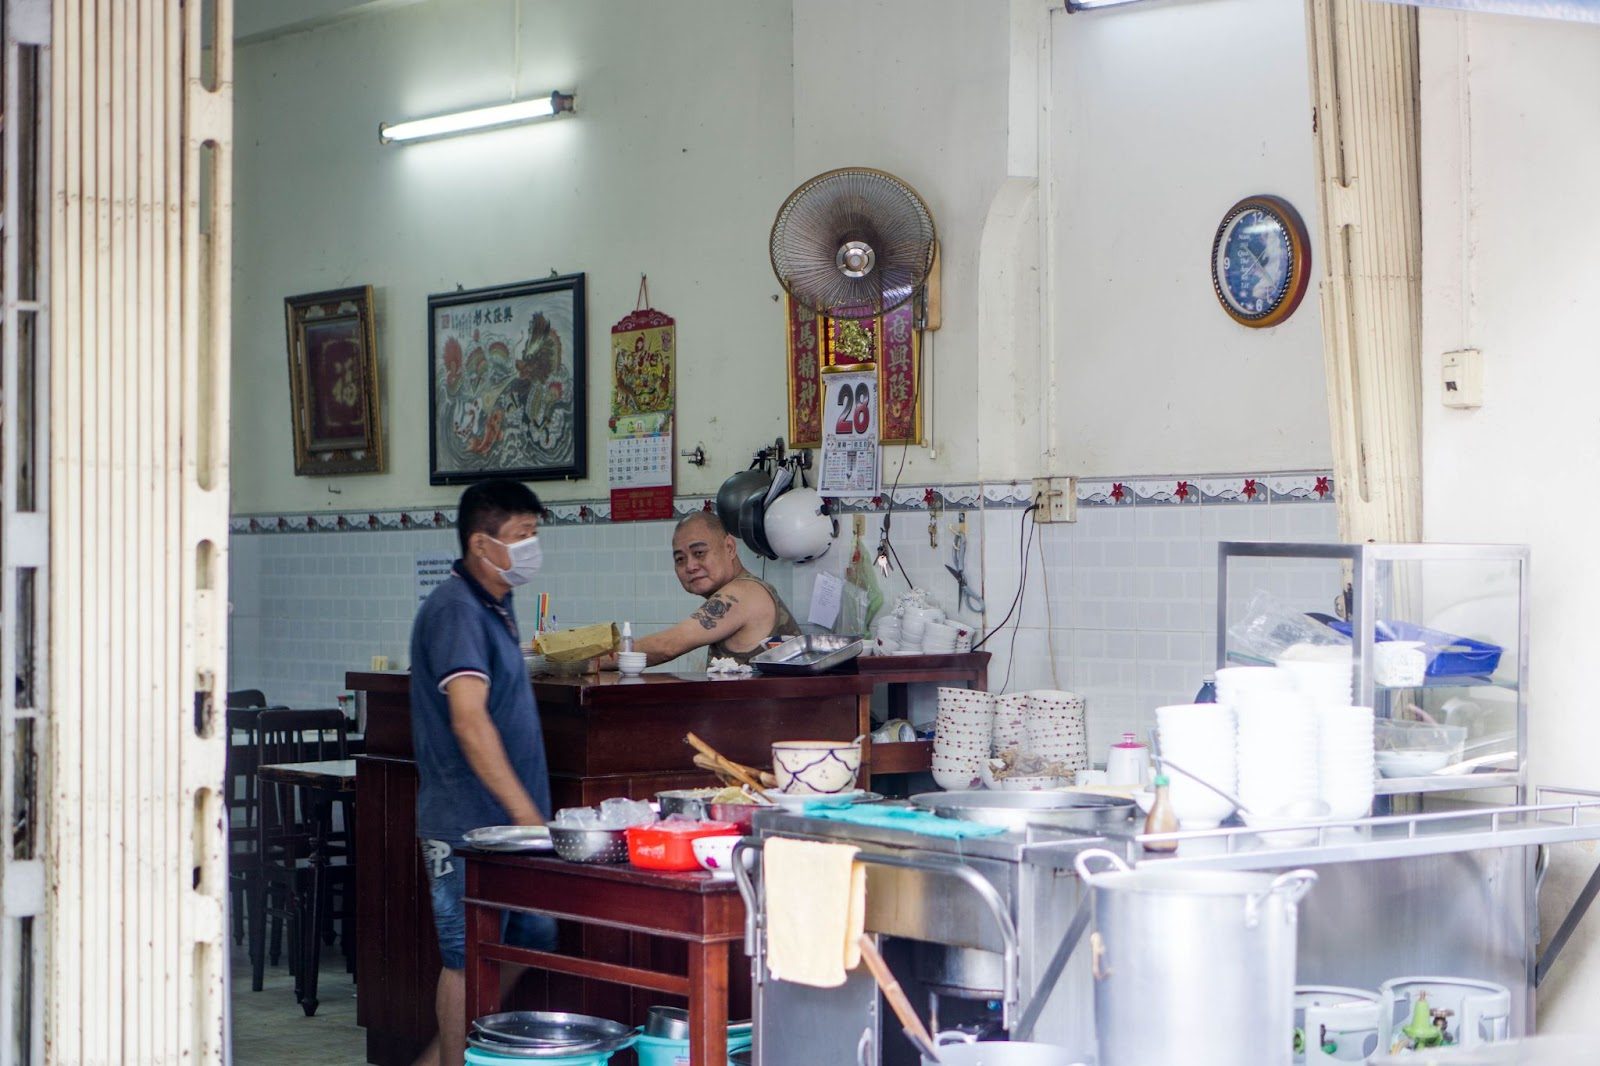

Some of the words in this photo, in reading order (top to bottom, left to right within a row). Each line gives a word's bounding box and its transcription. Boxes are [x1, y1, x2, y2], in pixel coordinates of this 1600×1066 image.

[1252, 211, 1264, 223] 12
[1224, 257, 1230, 270] 9
[1256, 298, 1262, 312] 6
[888, 303, 909, 401] 意興隆
[836, 382, 870, 434] 28
